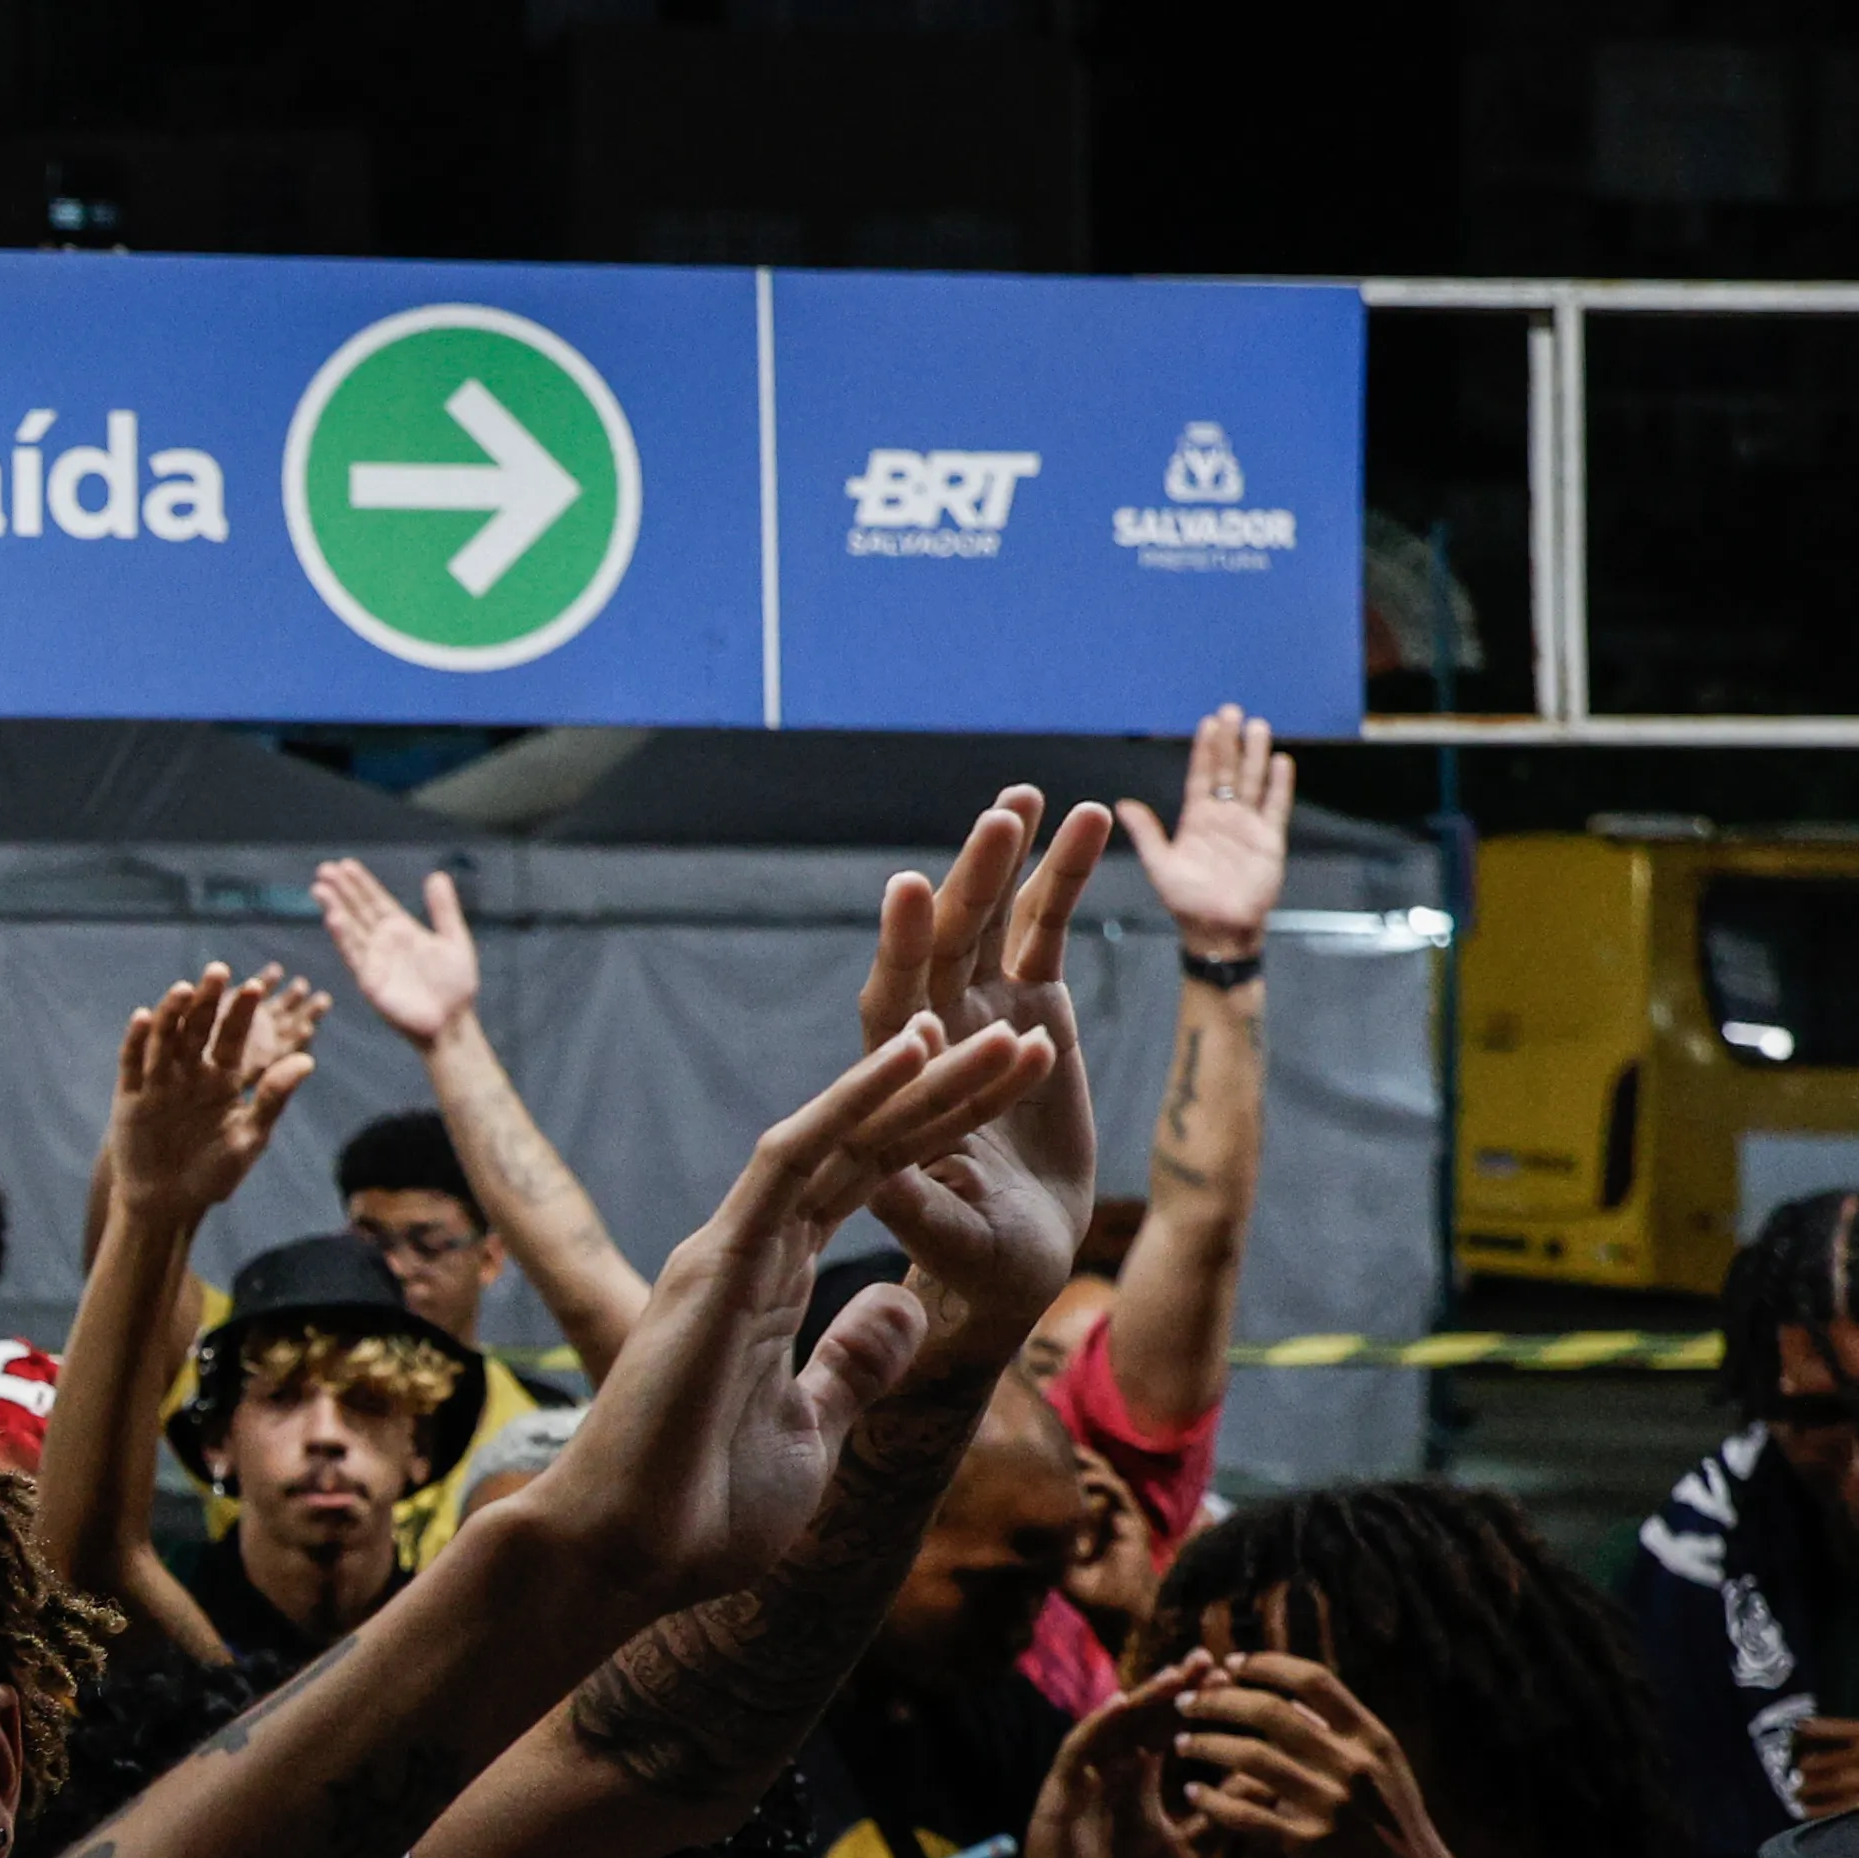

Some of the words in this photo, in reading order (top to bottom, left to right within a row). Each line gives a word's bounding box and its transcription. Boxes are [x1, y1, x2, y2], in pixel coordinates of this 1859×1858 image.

[845, 449, 1041, 528] BRT
[846, 528, 1002, 558] SALVADOR
[1112, 506, 1296, 550] SALVADOR
